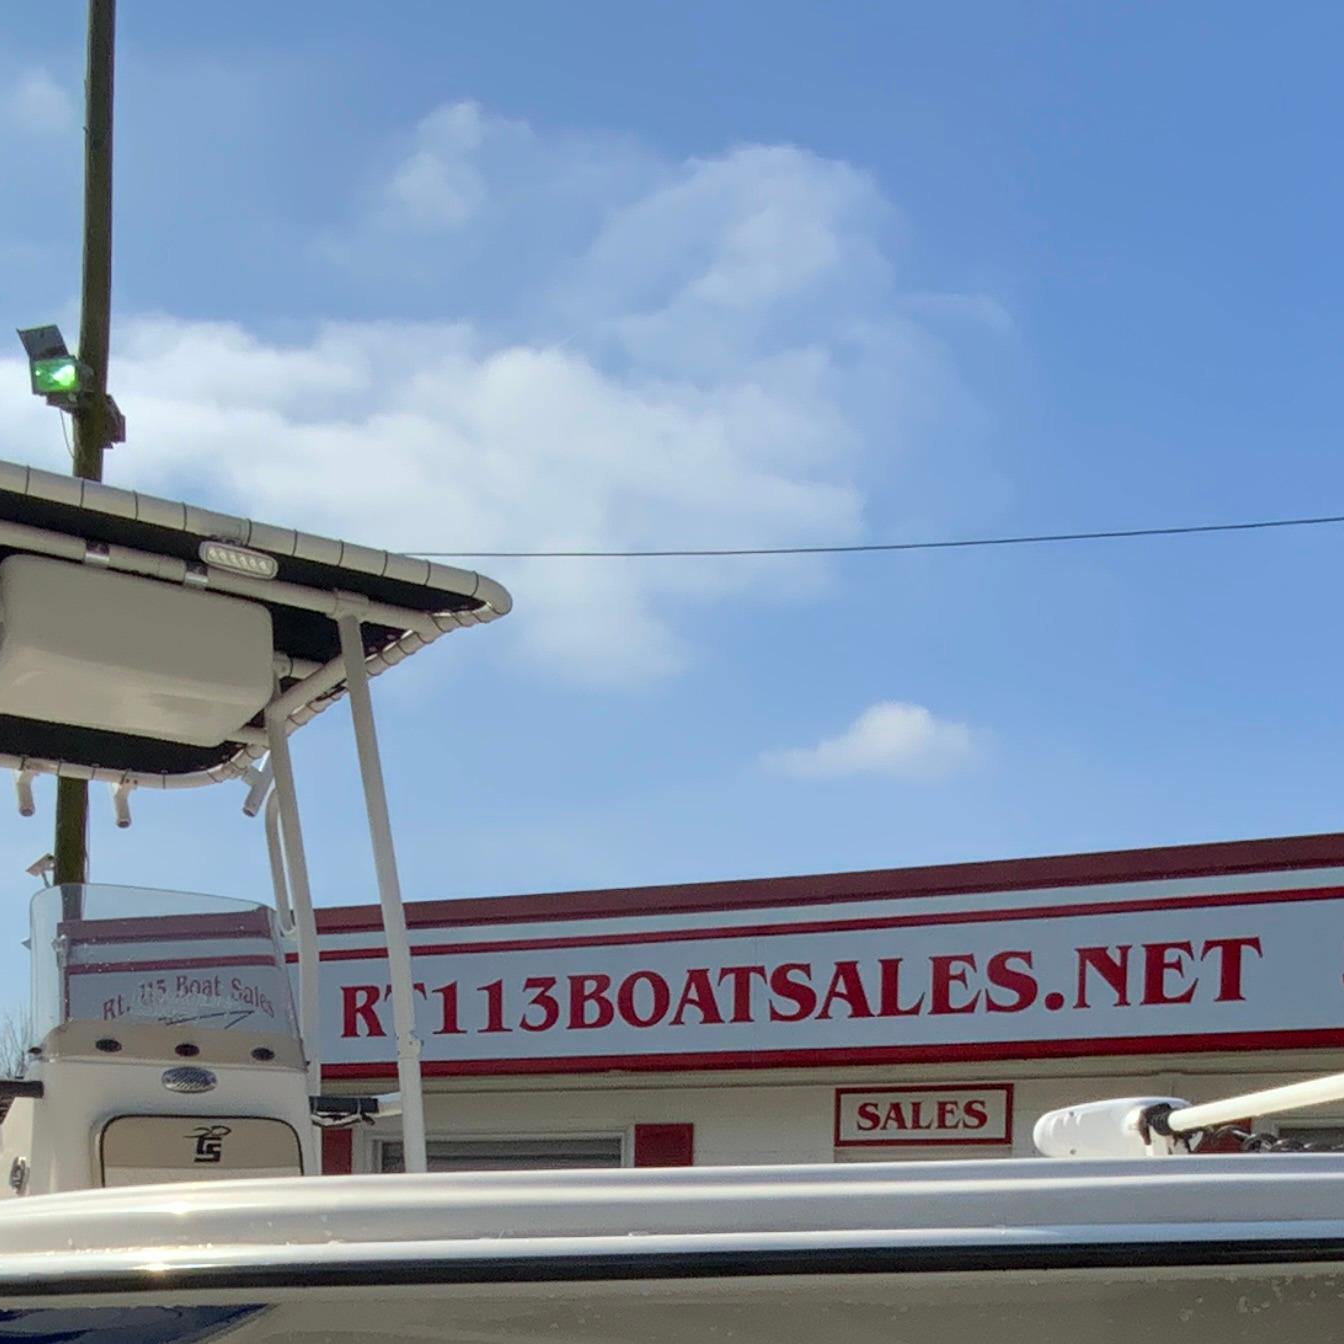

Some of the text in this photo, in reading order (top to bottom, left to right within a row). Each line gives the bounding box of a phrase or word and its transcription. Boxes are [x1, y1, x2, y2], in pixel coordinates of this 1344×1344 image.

[176, 975, 221, 999] Boat
[231, 977, 274, 1018] Sales
[857, 1100, 988, 1131] SALES
